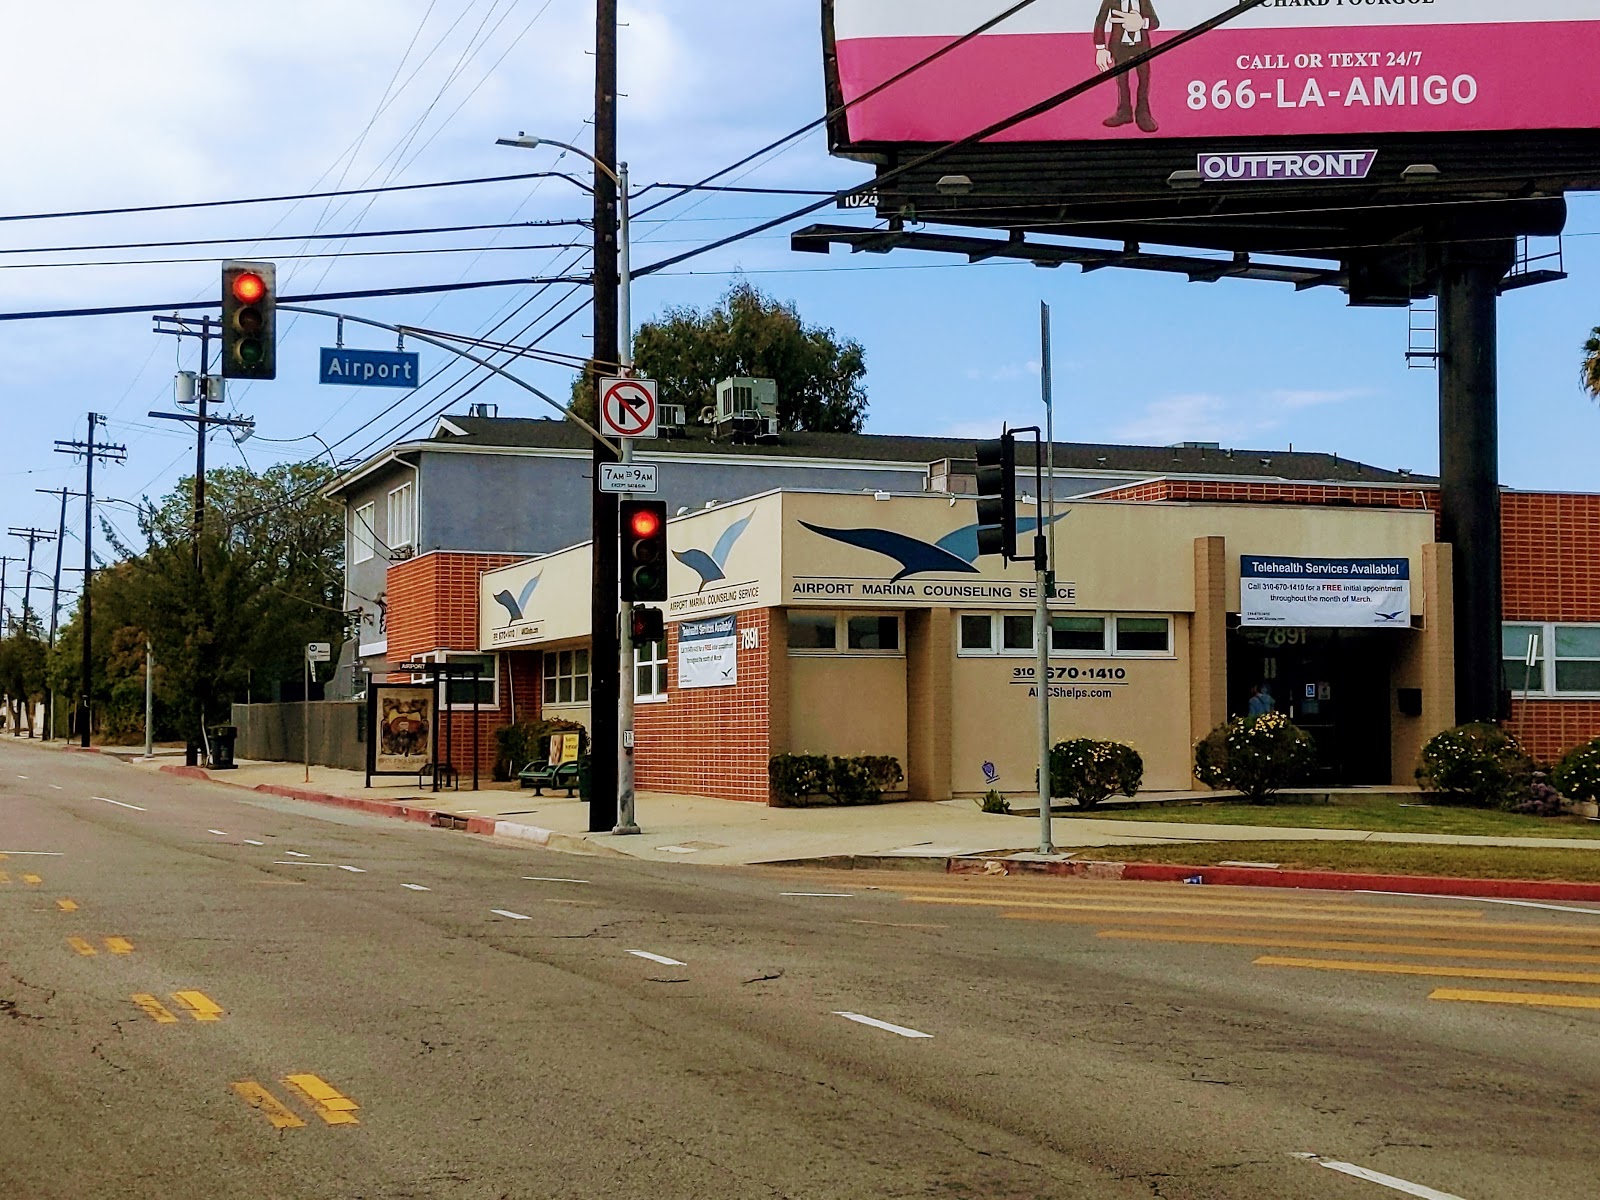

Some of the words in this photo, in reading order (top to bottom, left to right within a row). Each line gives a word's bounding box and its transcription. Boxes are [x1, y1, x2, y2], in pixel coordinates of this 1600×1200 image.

[1236, 55, 1290, 69] CALL
[1294, 54, 1323, 68] OR
[1328, 53, 1381, 67] TEXT
[1386, 51, 1422, 66] 24/7
[1187, 74, 1477, 110] 866-LA-AMIGO
[1204, 154, 1366, 178] OUTFRONT
[328, 358, 411, 380] Airport
[1252, 562, 1303, 573] Telehealth
[1306, 563, 1348, 574] Services
[1350, 563, 1399, 575] Available!
[670, 600, 688, 611] AIRPORT
[690, 597, 706, 608] MARINA
[708, 591, 737, 605] COUNSELING
[739, 587, 759, 600] SERVICE
[793, 583, 854, 594] AIRPORT
[862, 585, 915, 596] MARINA
[923, 586, 1012, 598] COUNSELING
[1019, 587, 1075, 599] SEICE
[1271, 594, 1306, 603] throughout
[1320, 595, 1341, 603] month
[741, 628, 759, 649] 7891
[1013, 667, 1035, 676] 310
[1029, 687, 1112, 699] ACShelps.com
